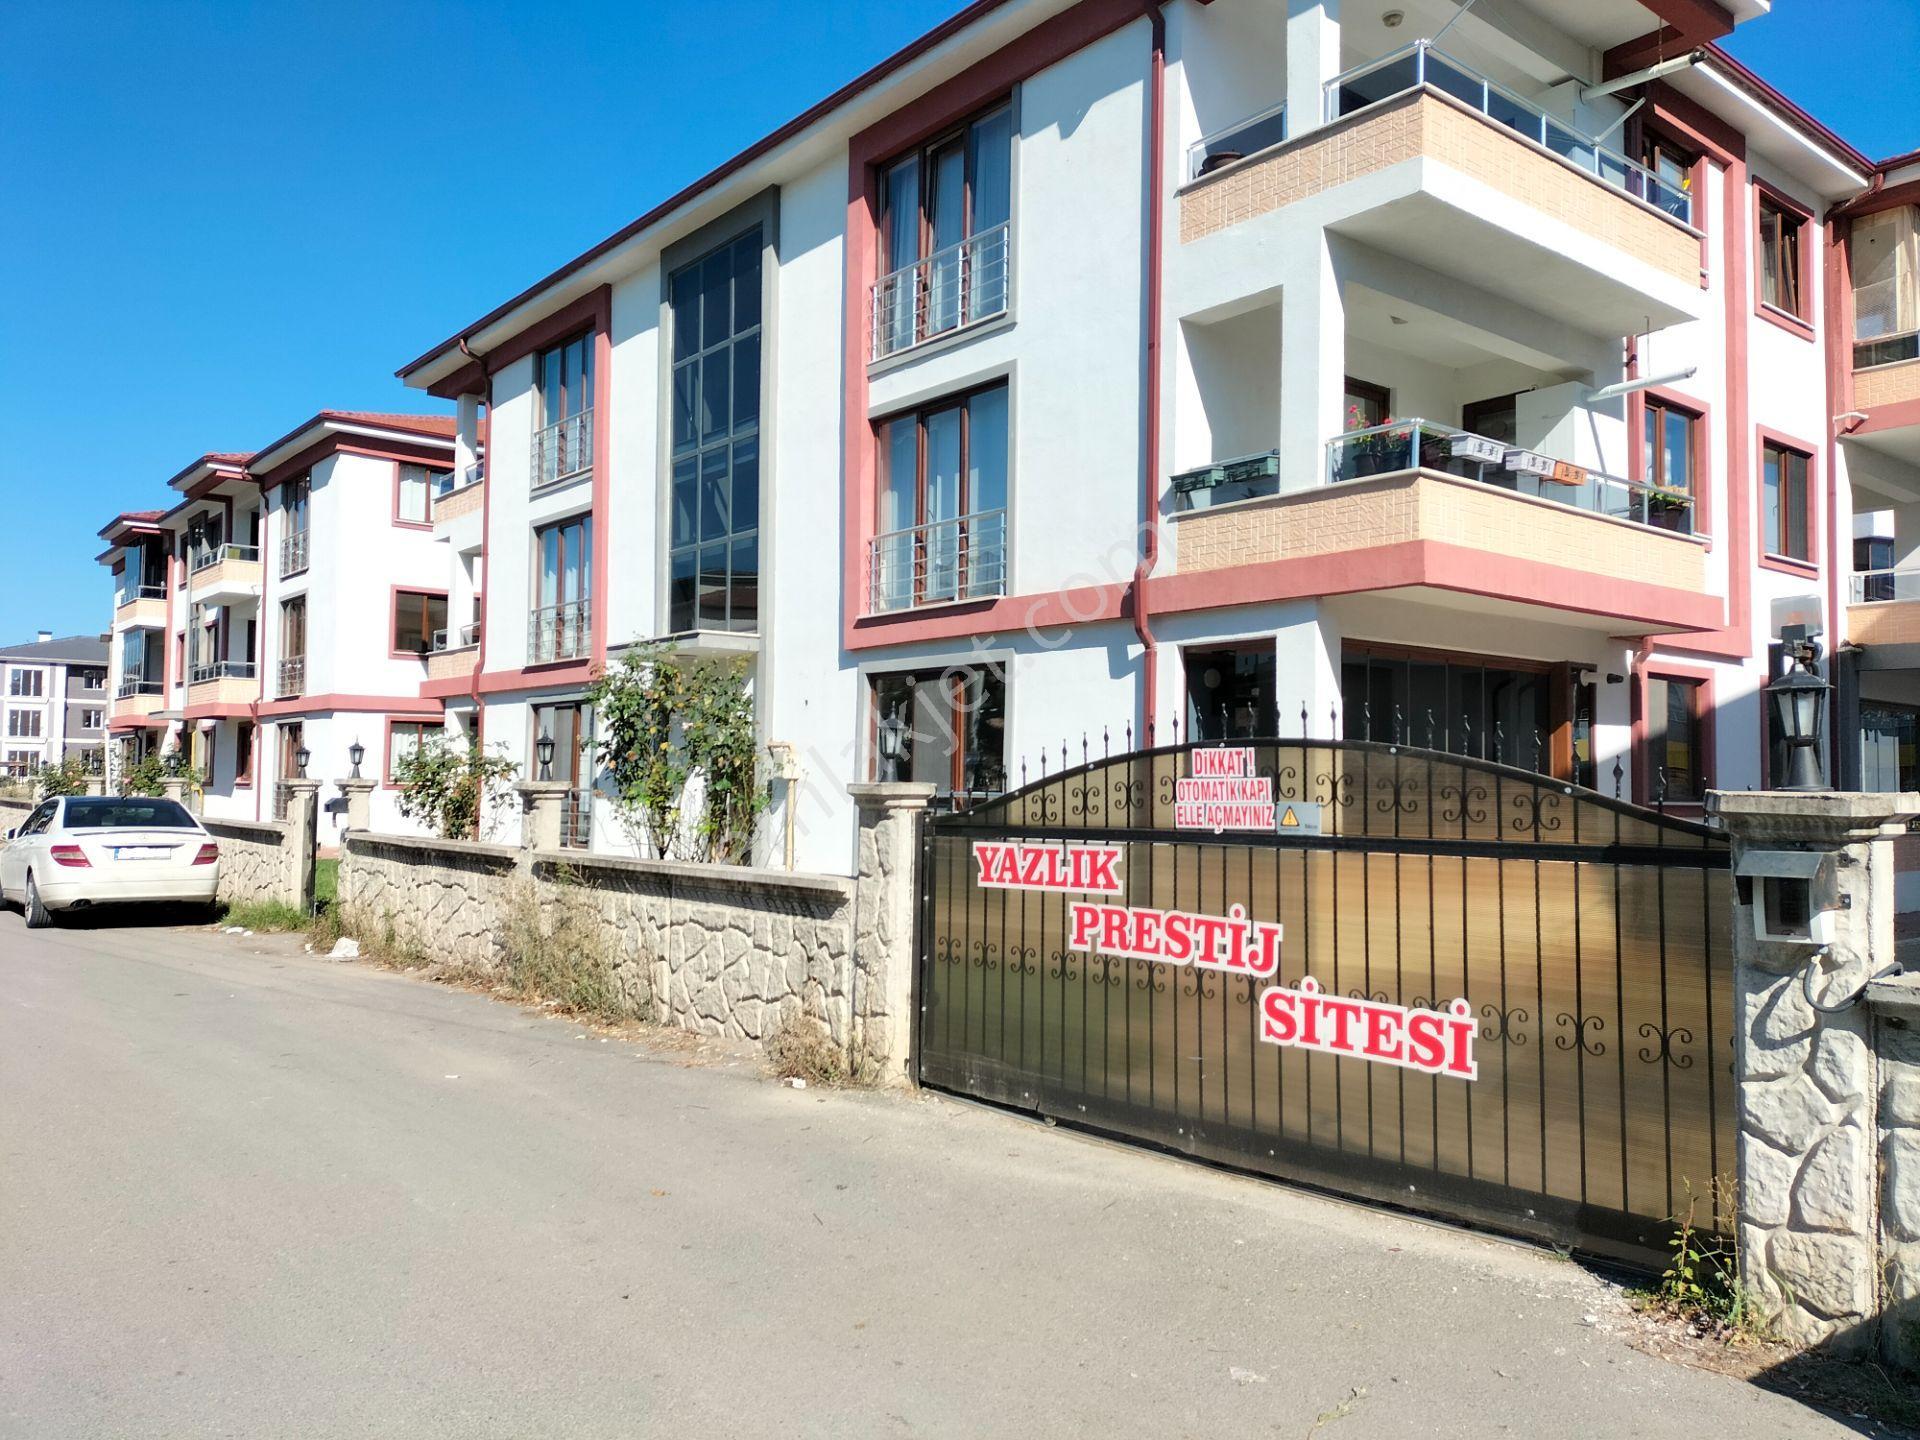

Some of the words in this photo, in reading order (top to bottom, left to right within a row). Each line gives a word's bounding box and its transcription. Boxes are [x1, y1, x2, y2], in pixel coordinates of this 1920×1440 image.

[1177, 775, 1239, 802] OTOMATİK
[1240, 779, 1270, 803] KAPI
[1177, 805, 1204, 826] ELLE
[1207, 804, 1273, 832] AÇMAYINIZ
[975, 846, 1119, 890] YAZLIK
[1073, 907, 1280, 973] PRESTİJ
[1264, 981, 1473, 1074] SİTESİ
